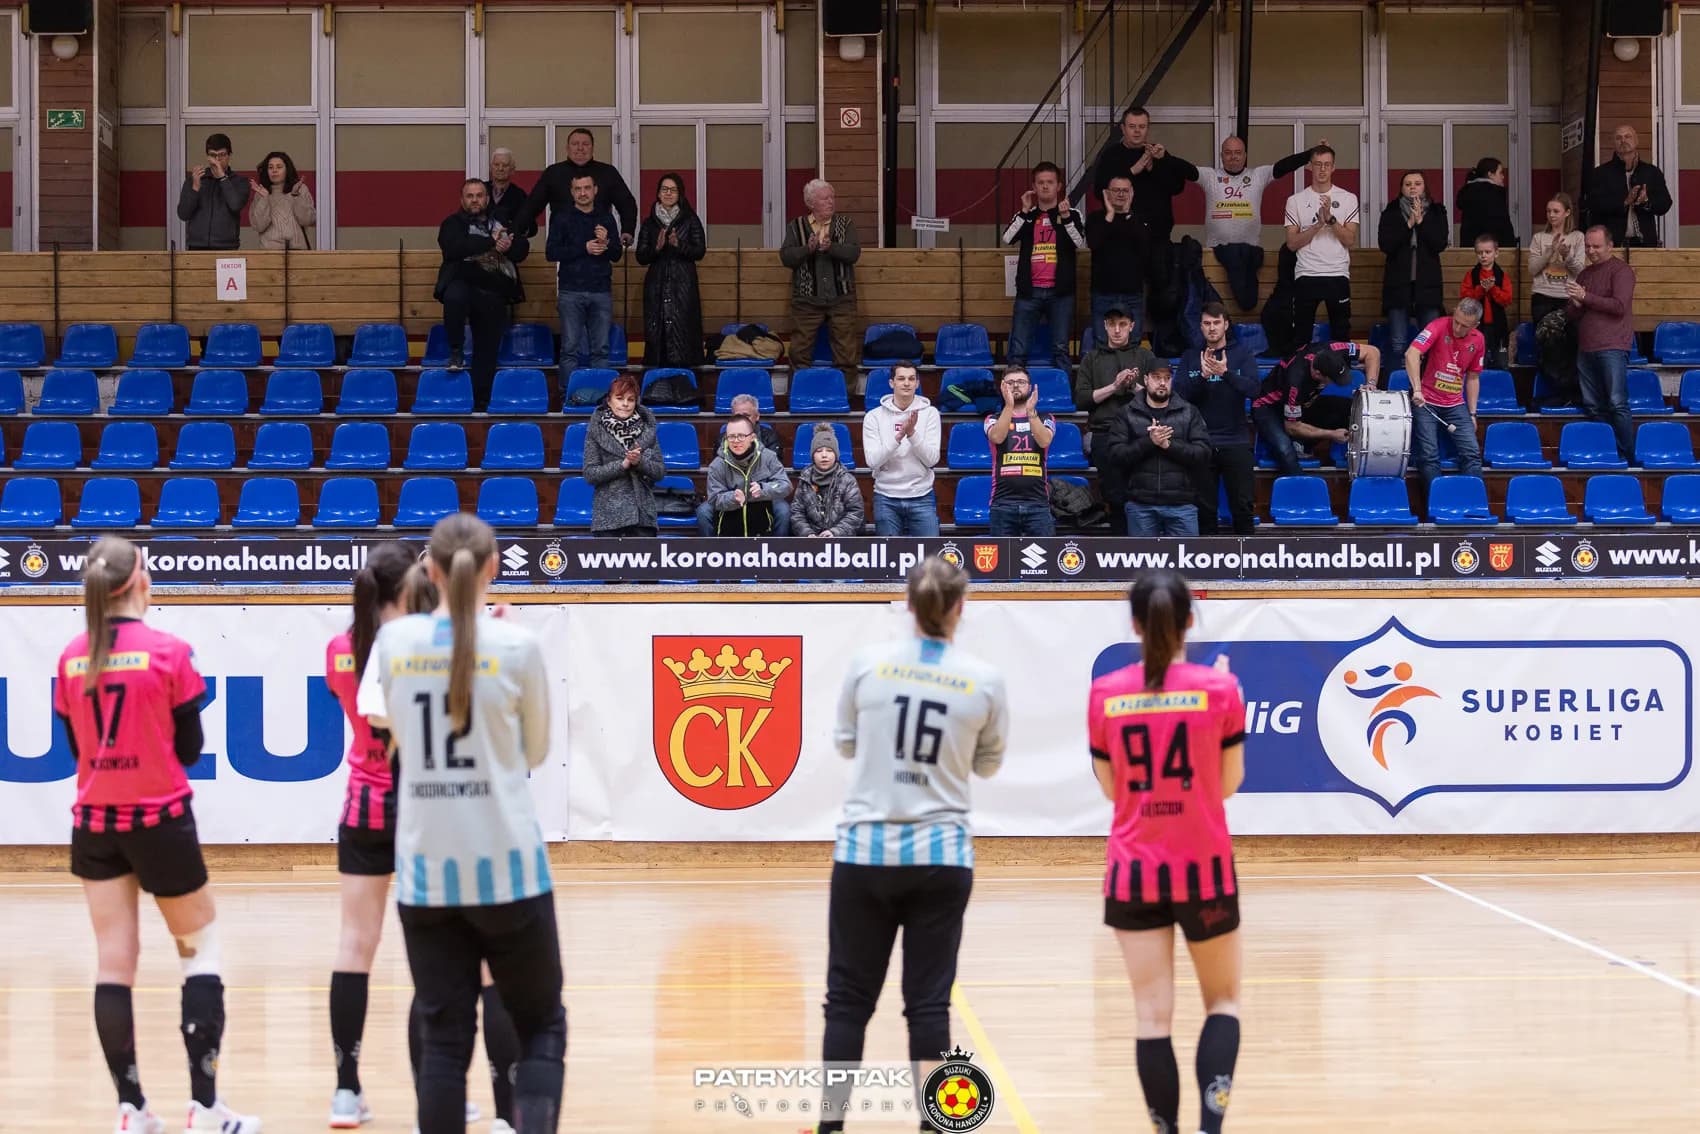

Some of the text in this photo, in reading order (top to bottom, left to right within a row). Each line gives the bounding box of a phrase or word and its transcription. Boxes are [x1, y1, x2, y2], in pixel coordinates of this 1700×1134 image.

[1224, 186, 1243, 199] 94
[1040, 230, 1057, 242] 17
[226, 277, 238, 290] A
[1011, 434, 1033, 452] 21
[578, 543, 924, 577] www.koronahandball.pl
[976, 555, 993, 569] CK
[1096, 543, 1440, 576] www.koronahandball.pl
[1491, 554, 1508, 568] CK
[1462, 689, 1664, 712] SUPERLIGA
[85, 683, 126, 748] 17
[414, 693, 474, 768] 12
[894, 696, 947, 764] 16
[1504, 724, 1623, 741] KOBIET
[669, 704, 772, 788] CK
[1122, 721, 1193, 792] 94
